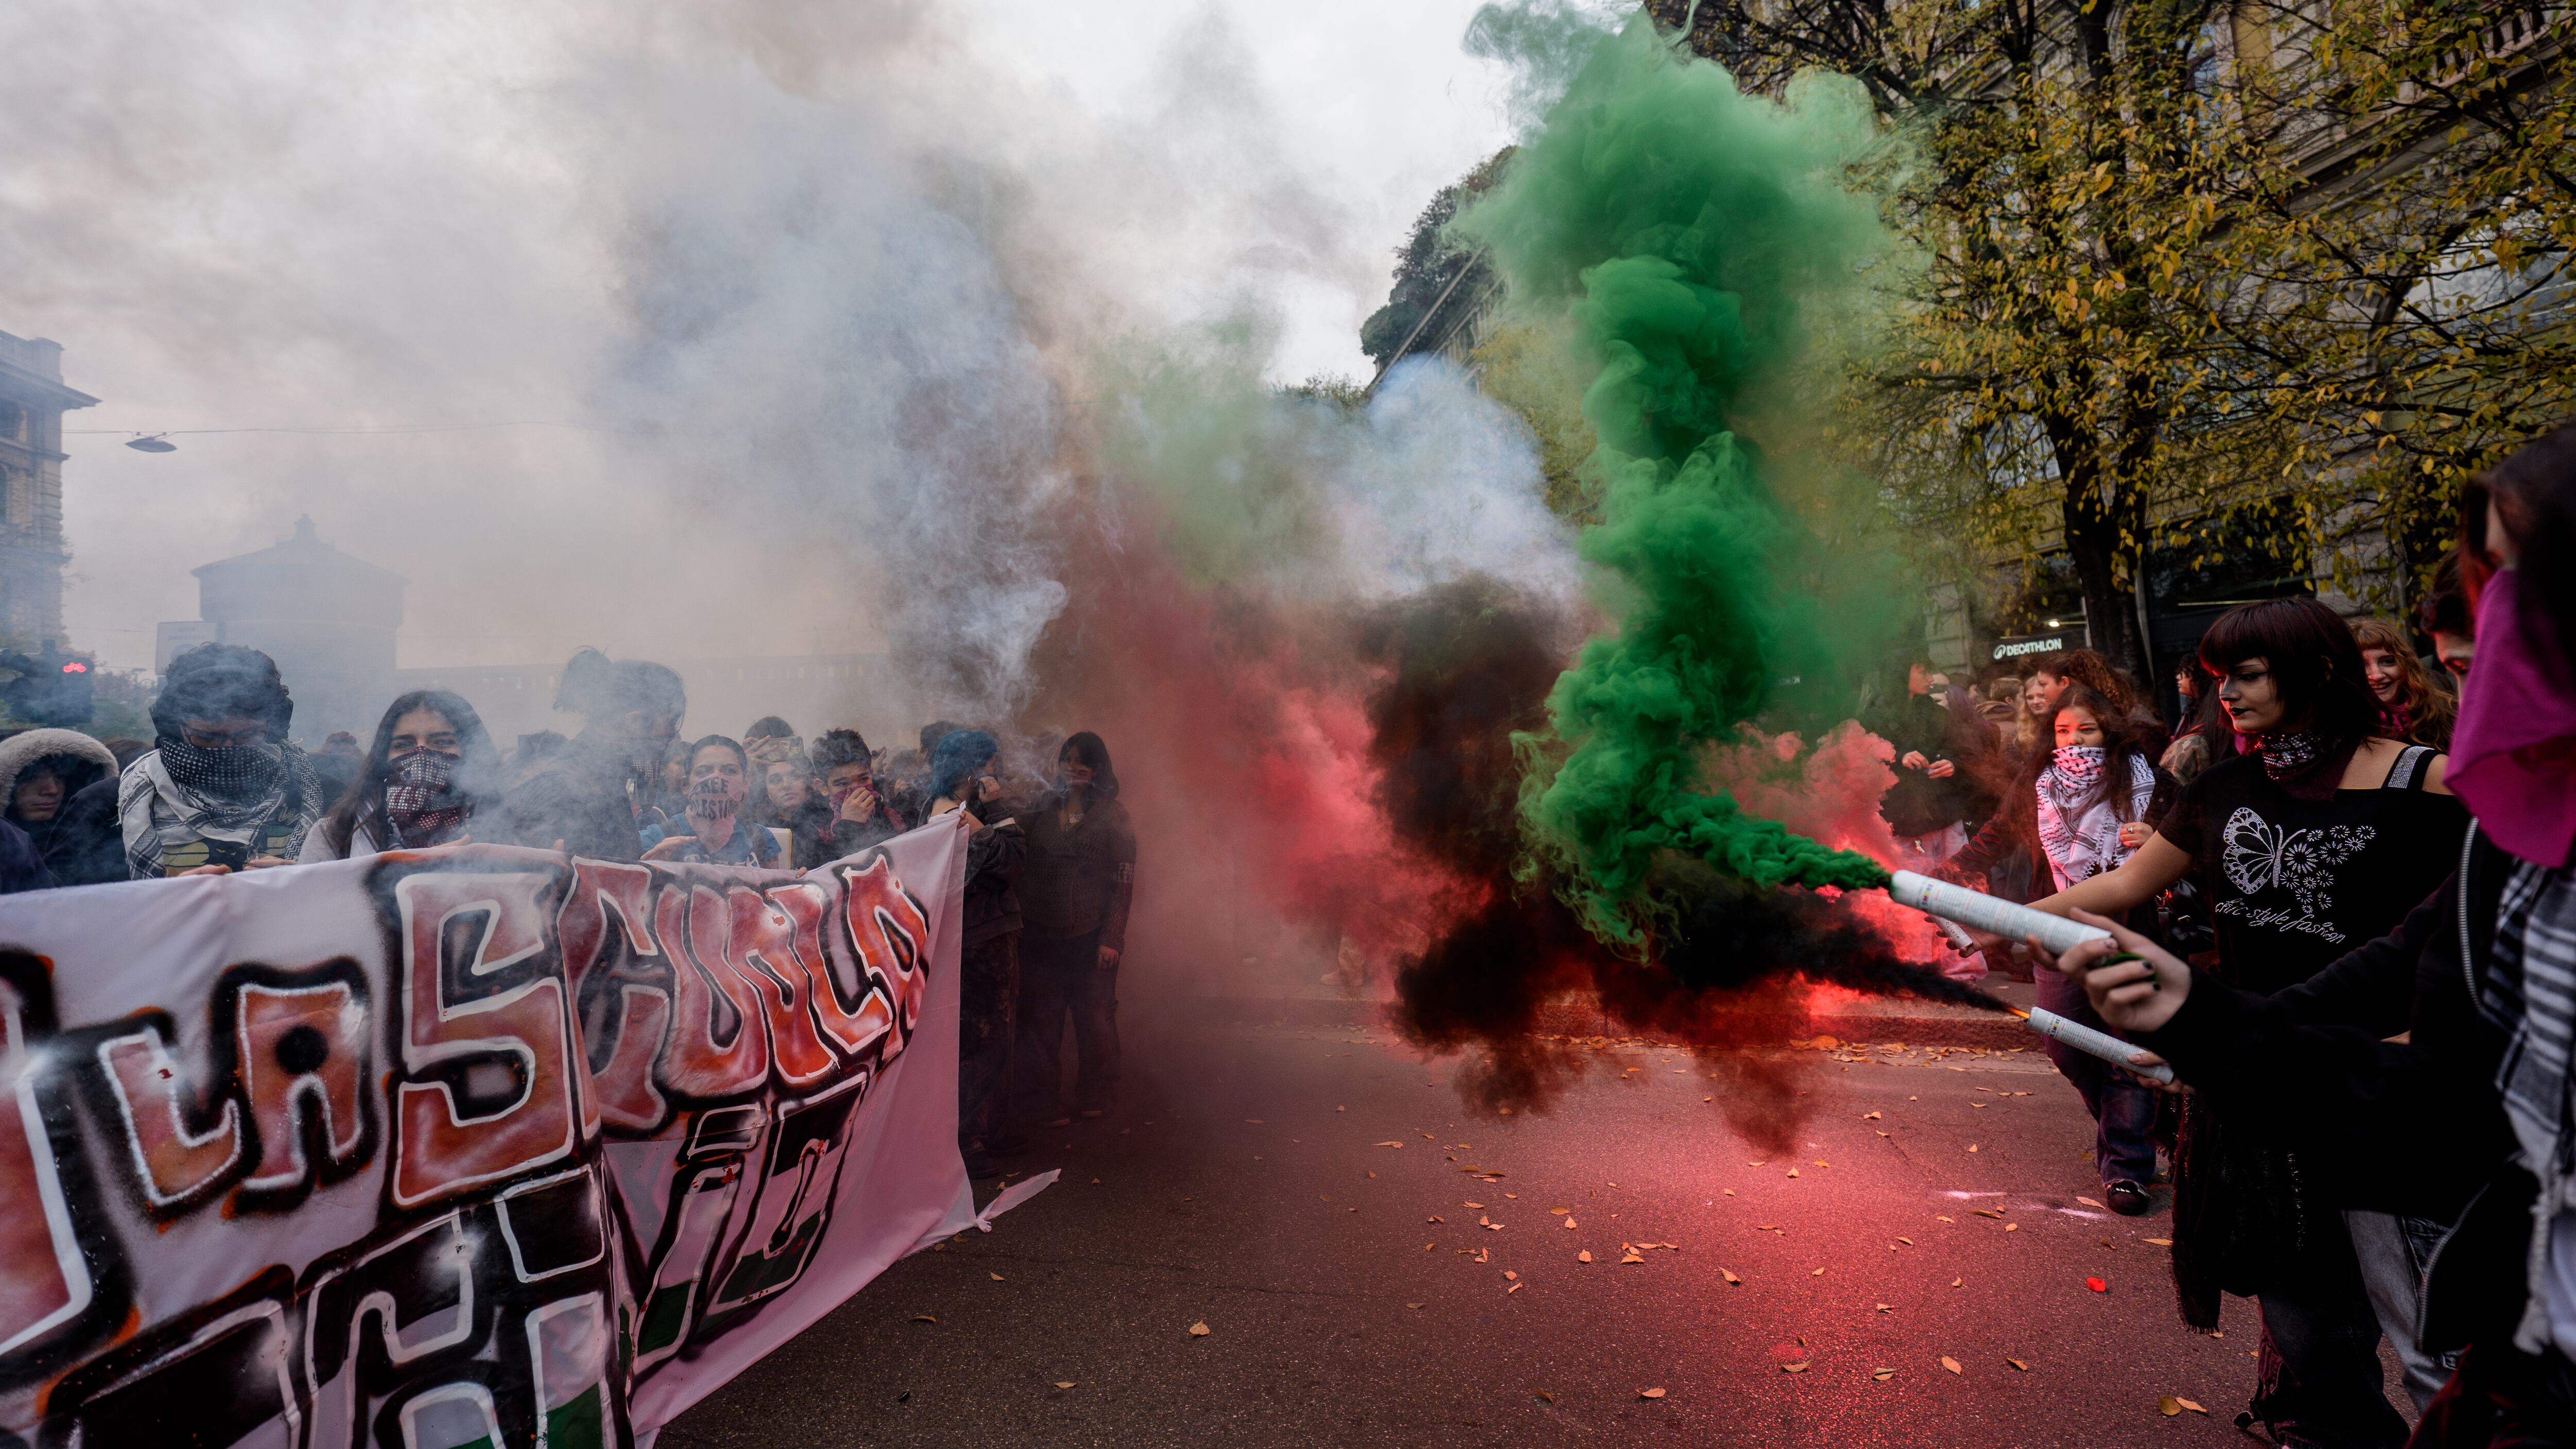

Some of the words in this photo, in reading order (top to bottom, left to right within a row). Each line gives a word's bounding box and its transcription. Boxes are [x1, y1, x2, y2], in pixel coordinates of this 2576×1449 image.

[2005, 638, 2062, 657] DECATHLON
[2246, 907, 2290, 927] style
[2279, 914, 2346, 945] fashion
[88, 968, 374, 1213] LA
[384, 850, 930, 1211] SCUOLA
